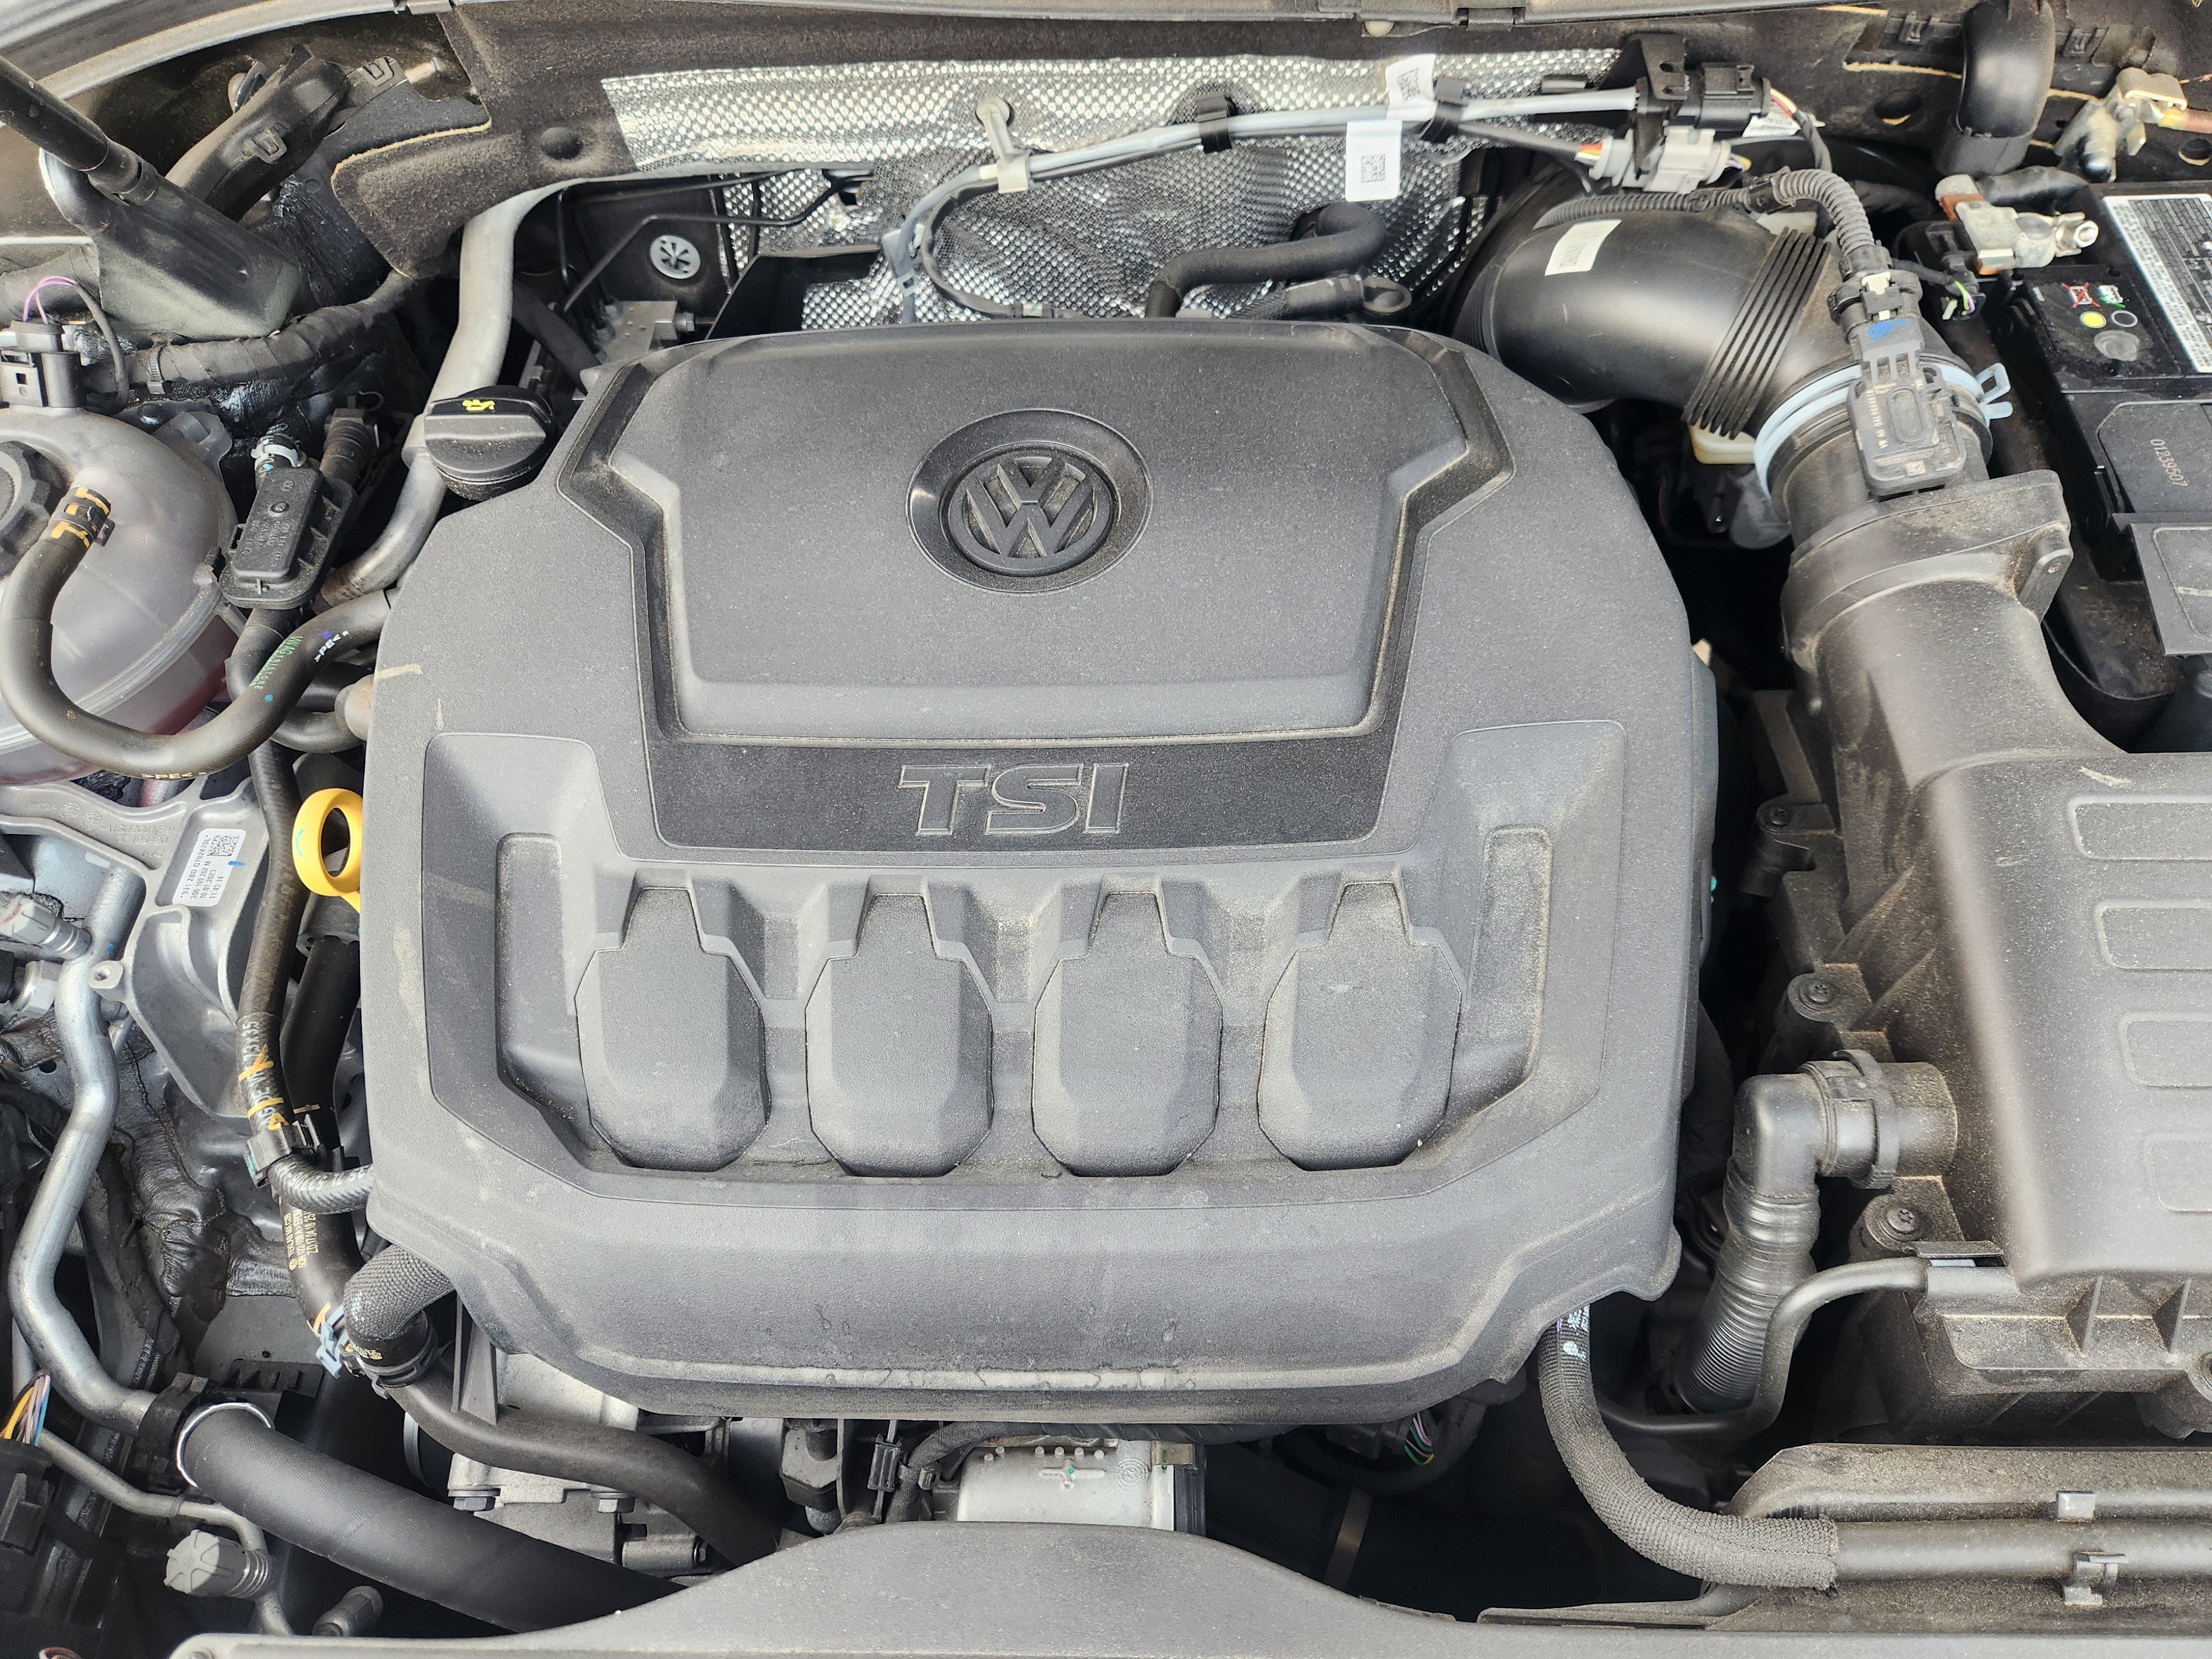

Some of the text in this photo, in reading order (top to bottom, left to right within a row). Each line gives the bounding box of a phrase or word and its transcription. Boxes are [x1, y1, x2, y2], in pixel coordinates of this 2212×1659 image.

[898, 763, 1129, 835] TSI
[200, 869, 217, 899] 10.07.2023
[286, 1233, 295, 1258] TEKLAS
